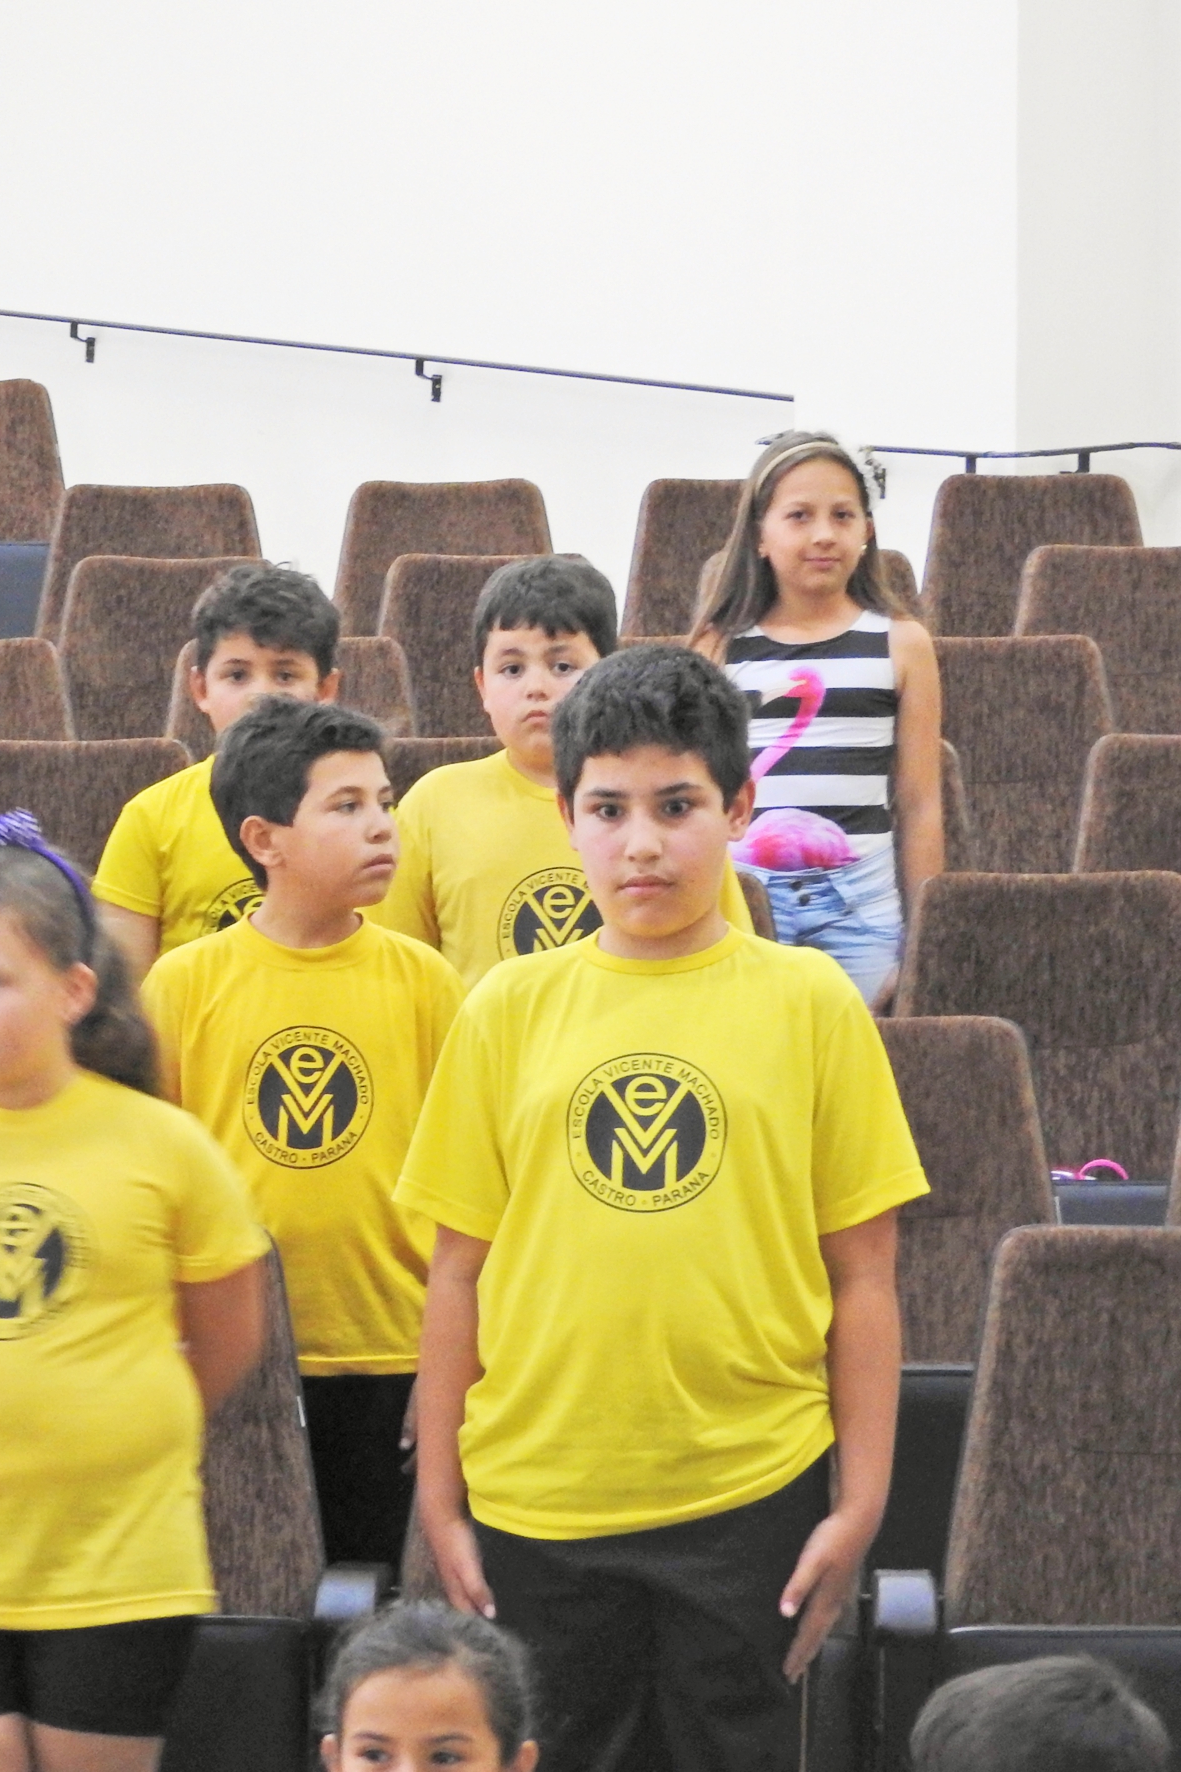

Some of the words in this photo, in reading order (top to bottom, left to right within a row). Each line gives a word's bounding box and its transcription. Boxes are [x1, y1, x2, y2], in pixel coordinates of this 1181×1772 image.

[572, 1078, 603, 1139] ESCOLA
[603, 1059, 675, 1078] VICENTE
[677, 1068, 720, 1140] MACHADO
[582, 1170, 636, 1207] CASTRO
